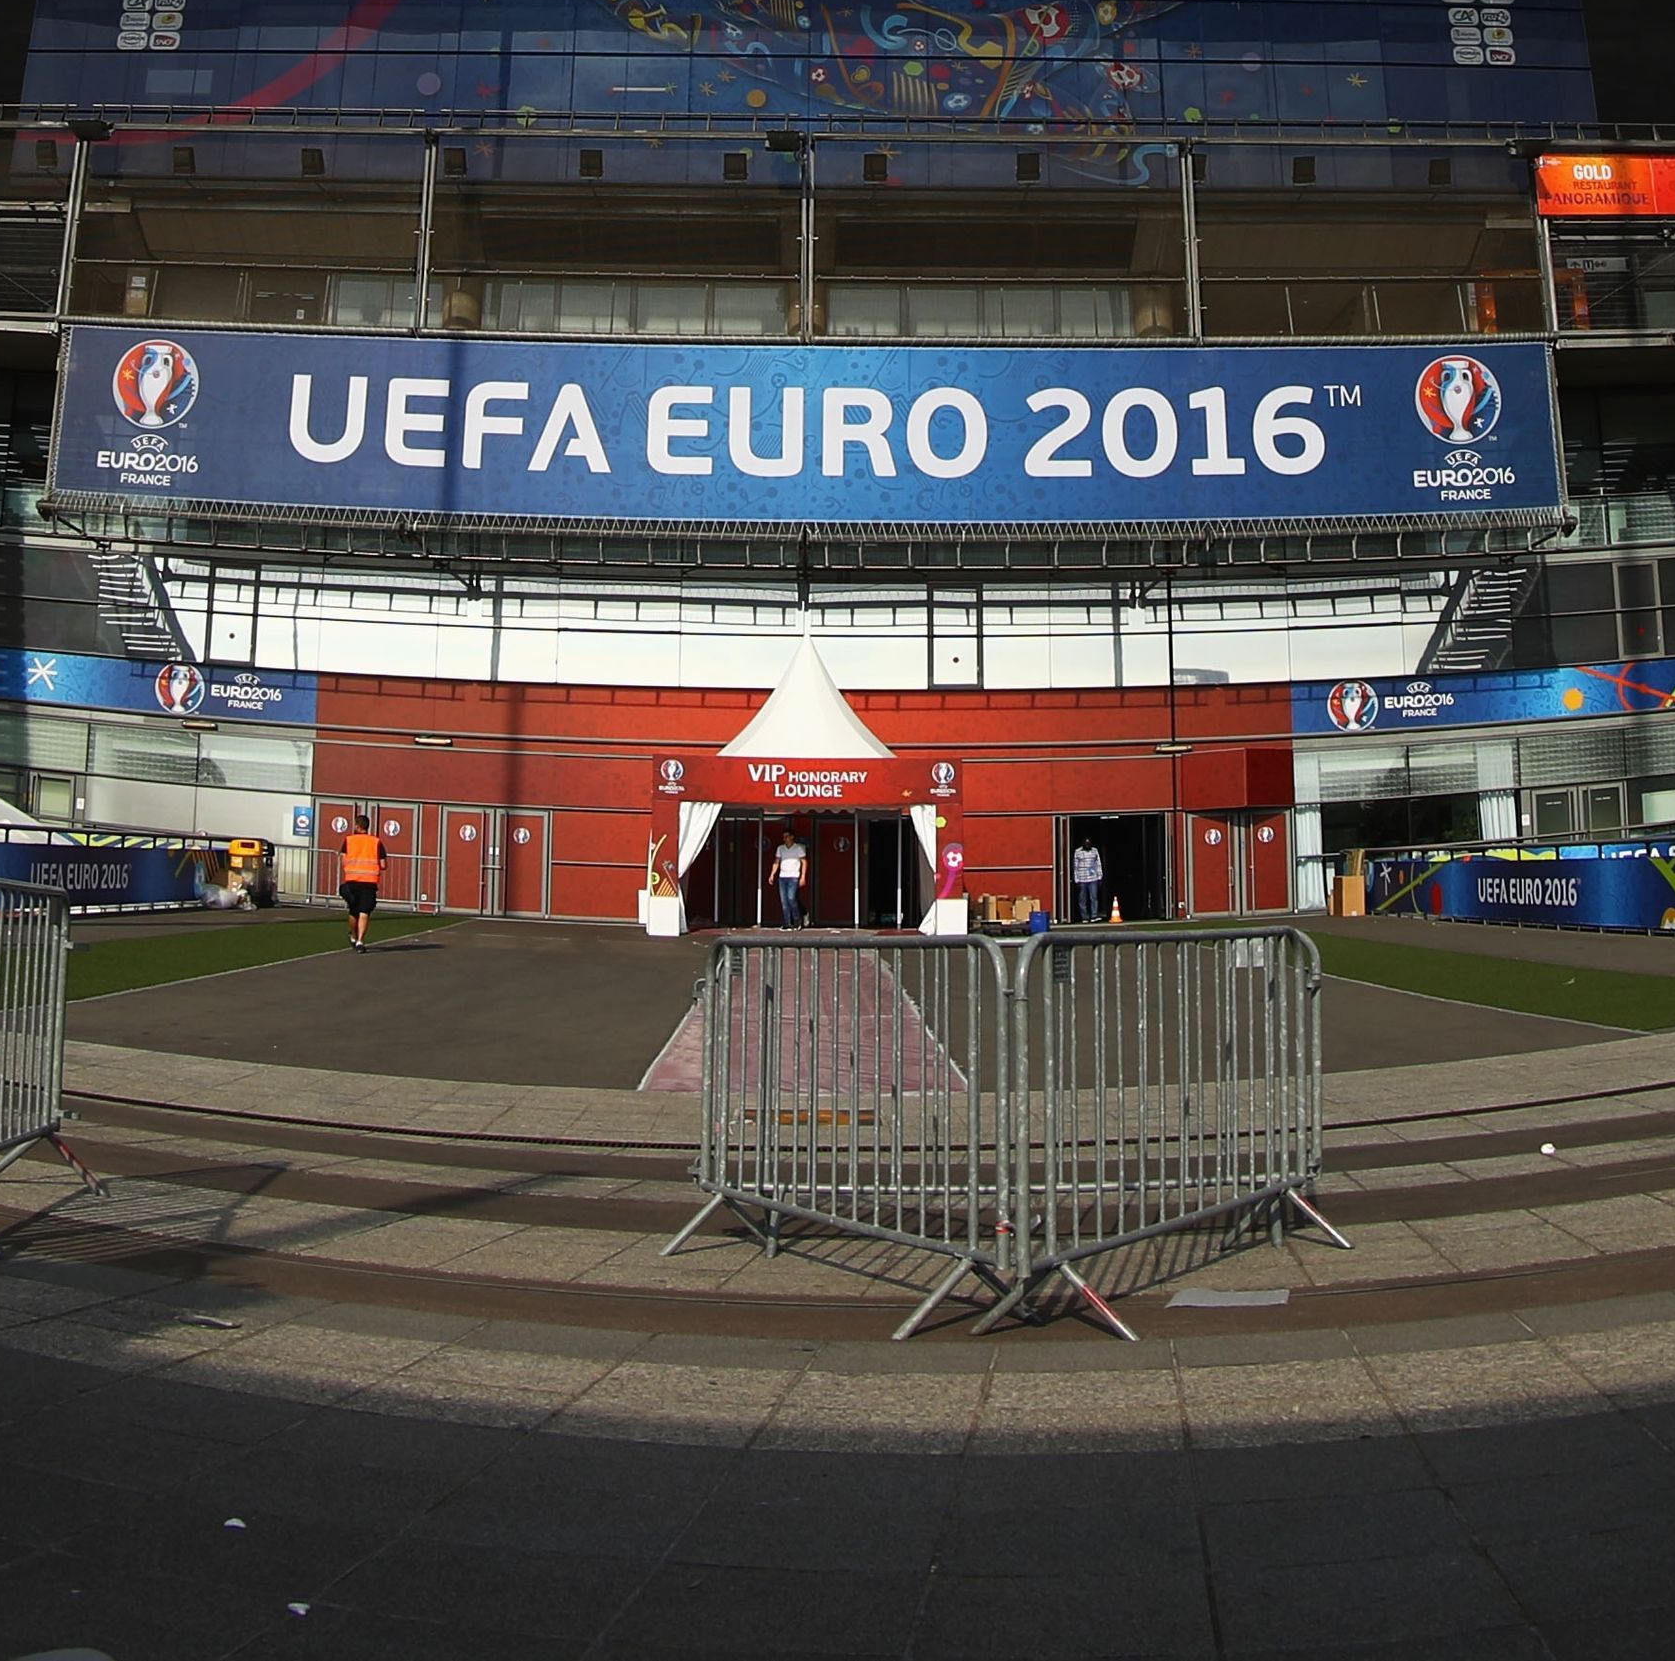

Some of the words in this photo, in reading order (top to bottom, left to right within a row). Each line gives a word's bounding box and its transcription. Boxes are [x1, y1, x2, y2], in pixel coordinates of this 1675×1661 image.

[1573, 165, 1612, 180] GOLD
[1544, 192, 1650, 205] PANORAMIQUE
[289, 373, 612, 473] UEFA
[646, 385, 989, 479] EURO
[1024, 385, 1327, 478] 2016
[132, 436, 165, 451] UEFA
[96, 450, 199, 473] EURO2016
[1446, 450, 1479, 466] UEFA
[120, 472, 172, 486] FRANCE
[1413, 466, 1516, 488] EURO2016
[1440, 489, 1492, 501] FRANCE
[210, 684, 283, 701] EURO2016
[227, 700, 264, 710] FRANCE
[1384, 693, 1455, 709] EURO2016
[1402, 708, 1437, 718] FRANCE
[747, 763, 786, 782] VIP
[788, 771, 868, 783] HONORARY
[774, 783, 843, 798] LOUNGE
[30, 862, 64, 888] UEFA
[66, 863, 99, 890] EURO
[100, 863, 129, 890] 2016
[1477, 877, 1508, 904] UEFA
[1509, 877, 1543, 906] EURO
[1544, 877, 1578, 907] 2016
